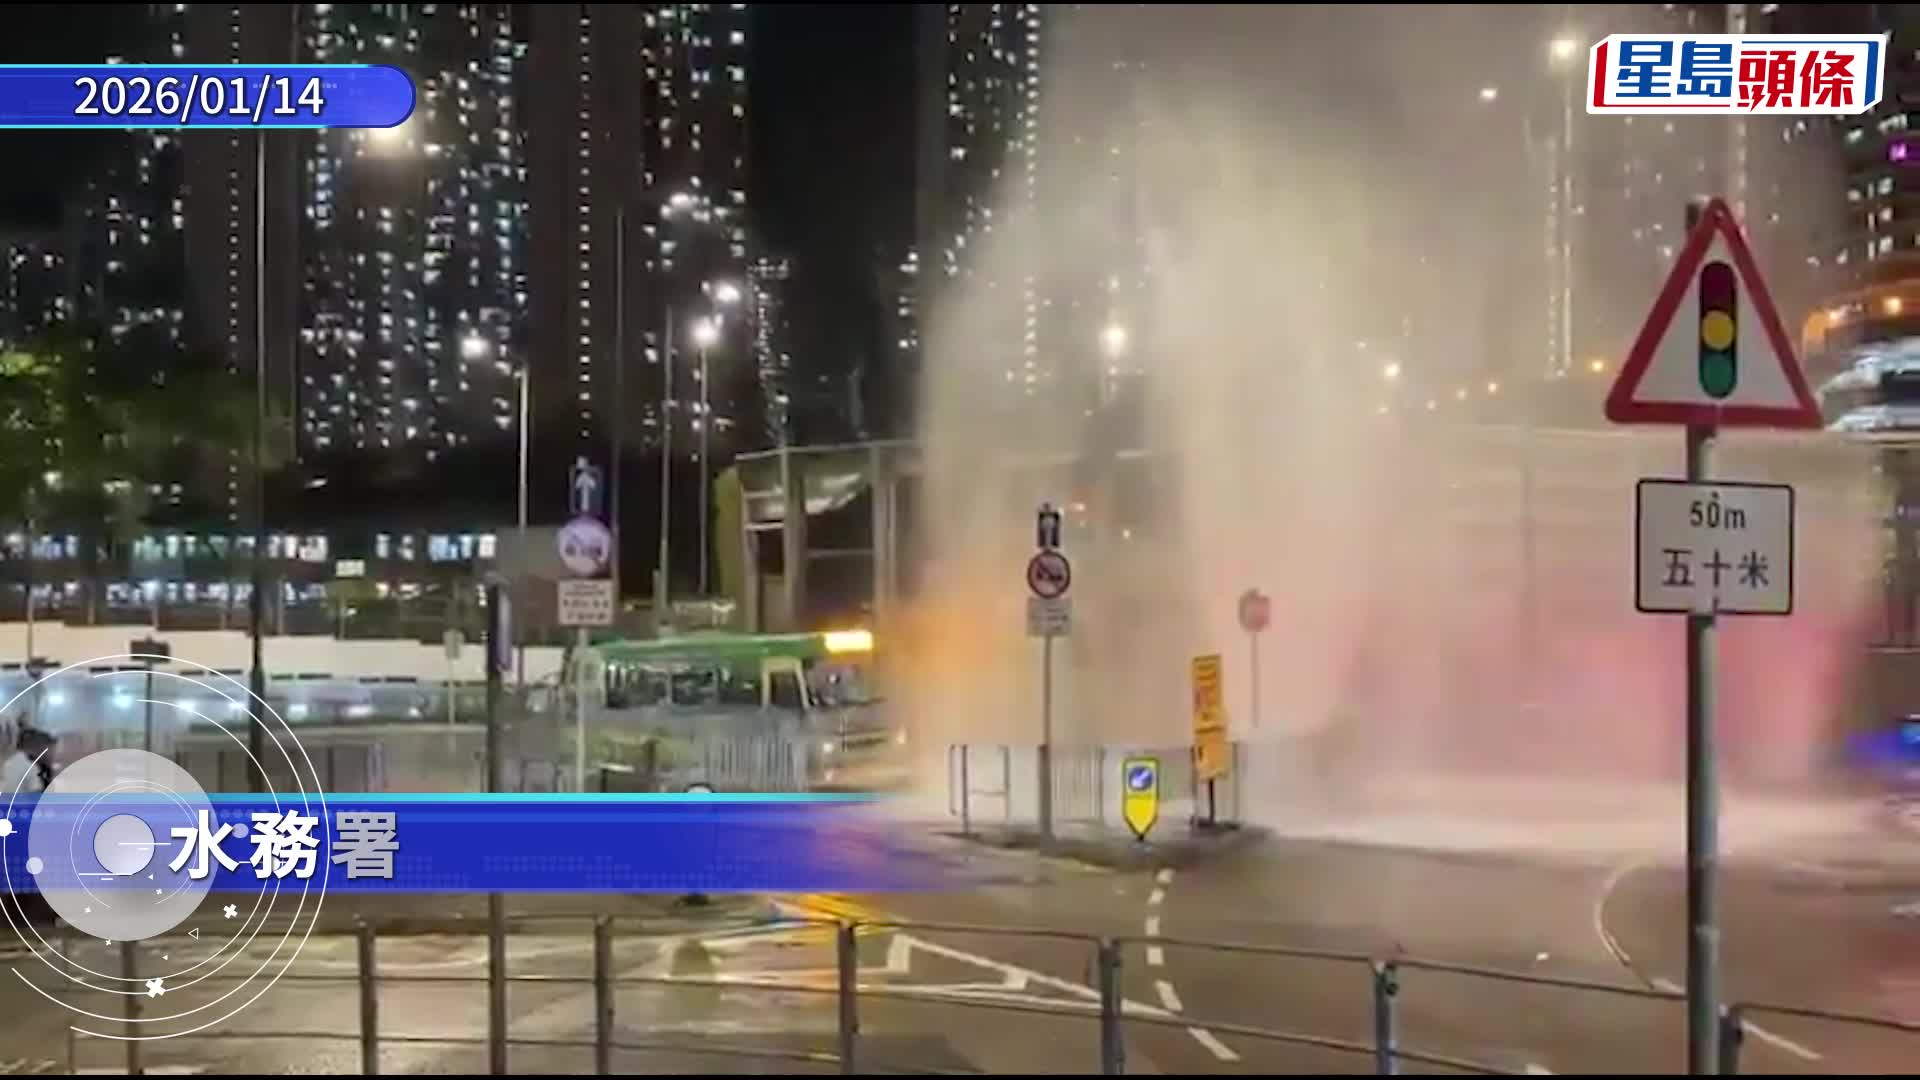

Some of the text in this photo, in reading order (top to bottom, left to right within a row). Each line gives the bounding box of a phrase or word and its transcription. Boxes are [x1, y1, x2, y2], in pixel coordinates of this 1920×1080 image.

[1690, 500, 1746, 529] 50m
[1661, 548, 1769, 589] 五十米
